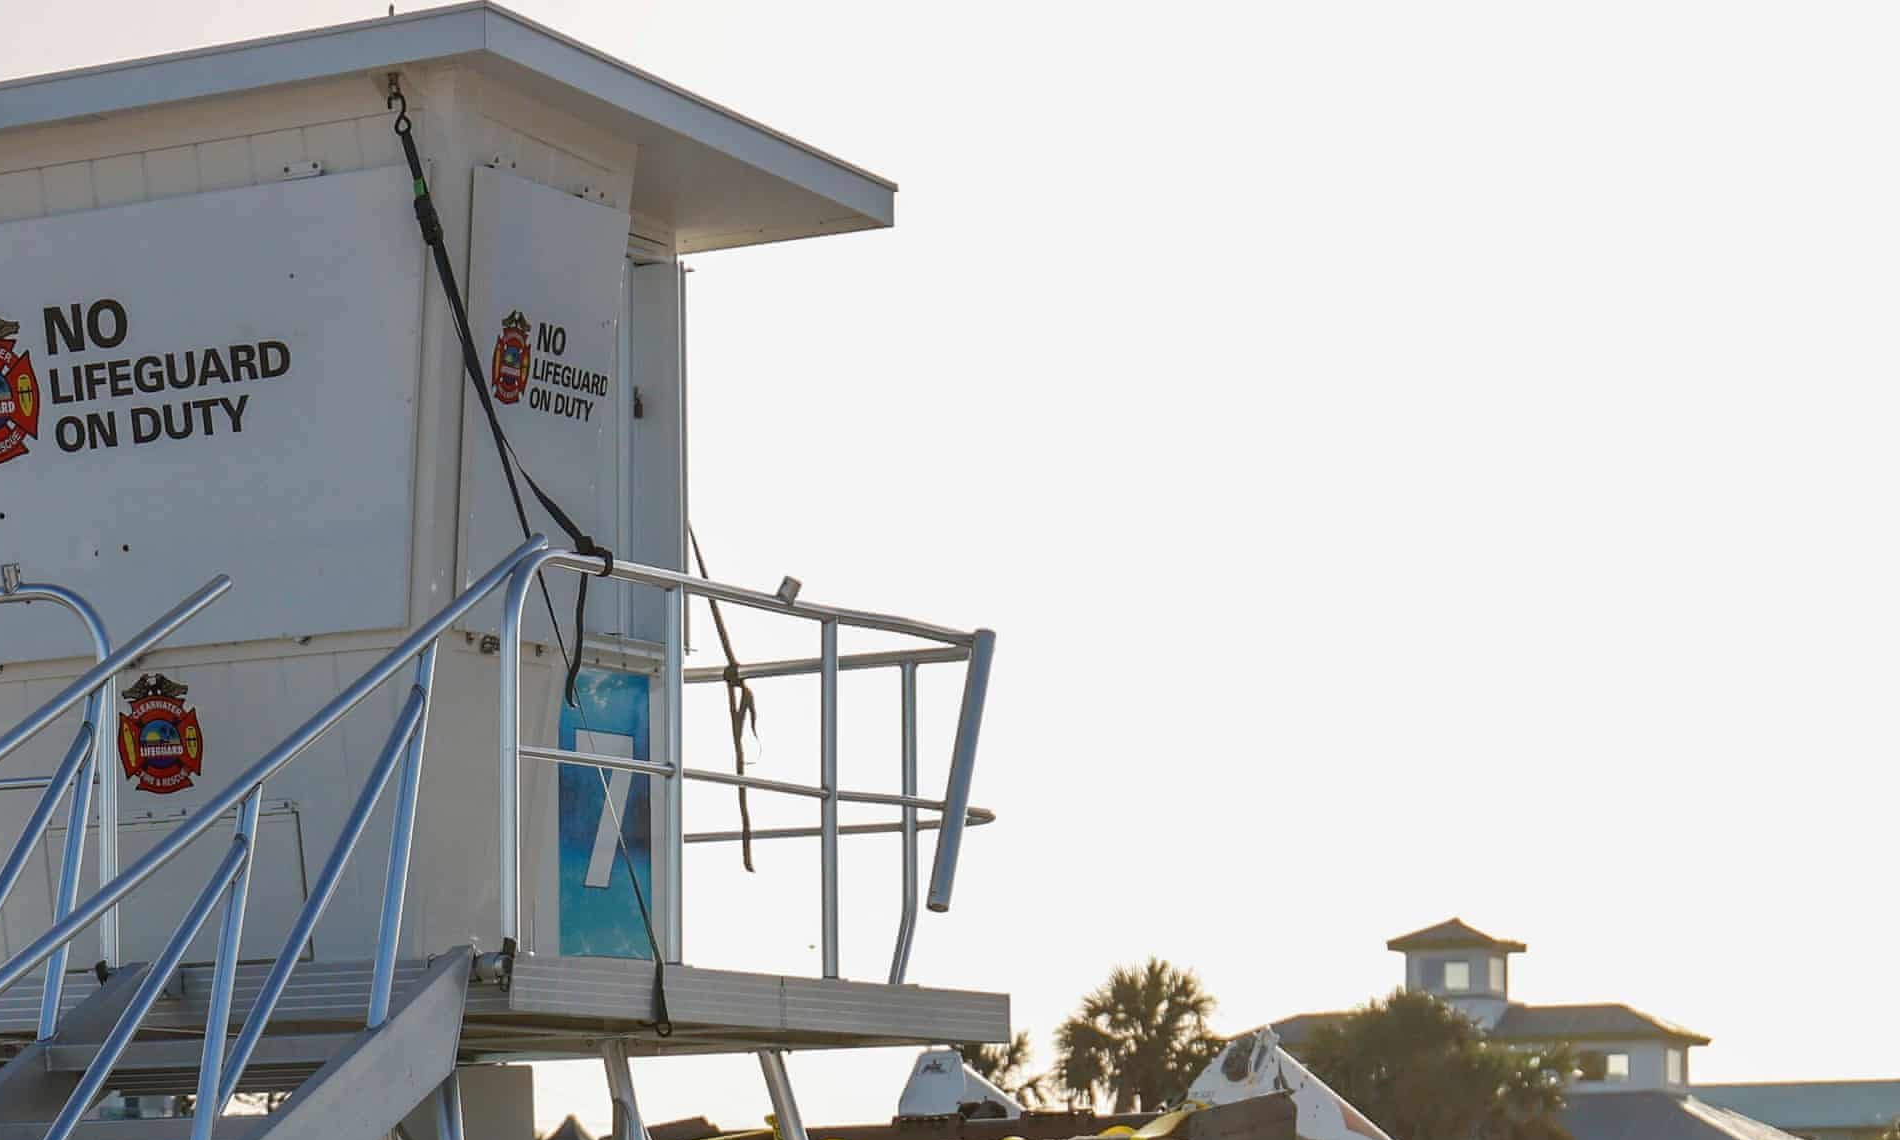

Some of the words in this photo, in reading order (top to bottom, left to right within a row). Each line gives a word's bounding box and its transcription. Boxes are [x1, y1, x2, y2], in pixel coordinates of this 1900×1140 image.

[43, 299, 128, 355] NO
[537, 322, 566, 355] NO
[49, 340, 291, 405] LIFEGUARD
[532, 358, 608, 397] LIFEGUARD
[55, 411, 118, 453] ON
[130, 395, 250, 444] DUTY
[530, 387, 551, 412] ON
[554, 393, 593, 422] DUTY
[574, 728, 634, 889] 7
